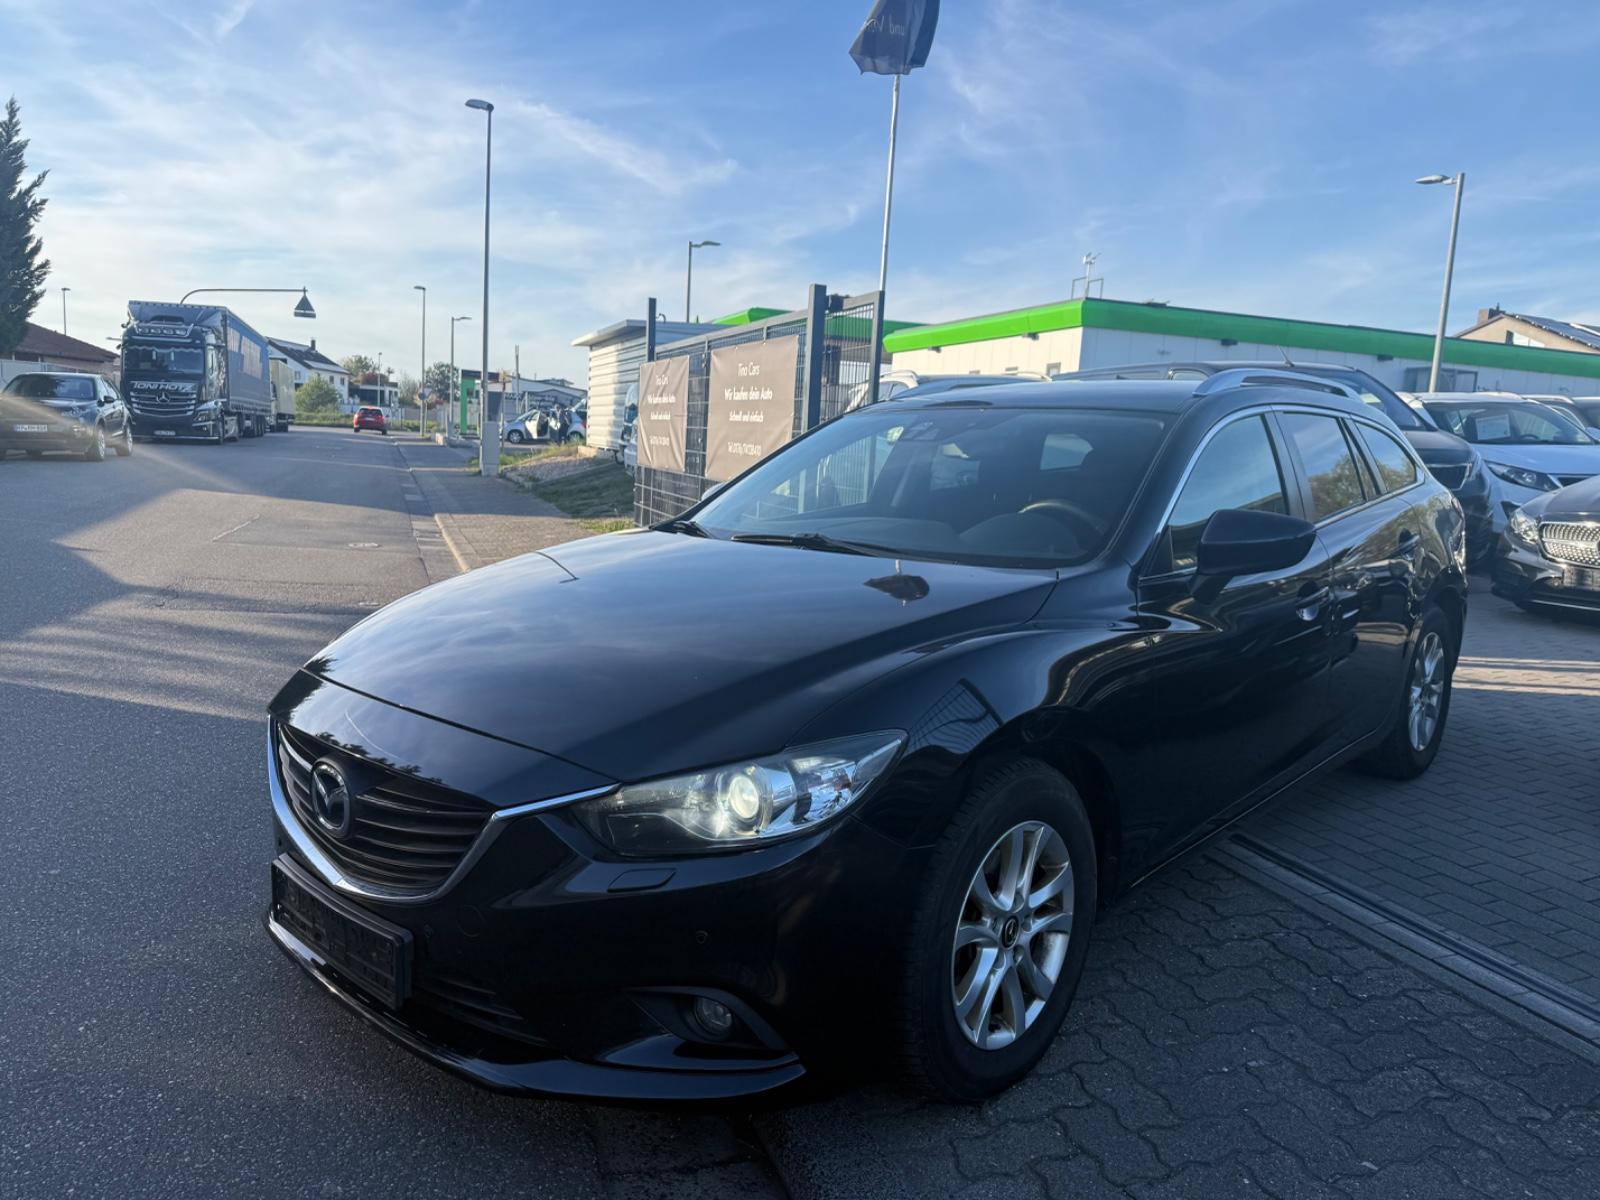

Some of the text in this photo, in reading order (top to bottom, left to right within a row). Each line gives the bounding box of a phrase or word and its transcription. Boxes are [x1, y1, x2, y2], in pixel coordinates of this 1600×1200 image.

[748, 361, 760, 376] Cars
[724, 385, 773, 401] Wir kaufen dein Auto
